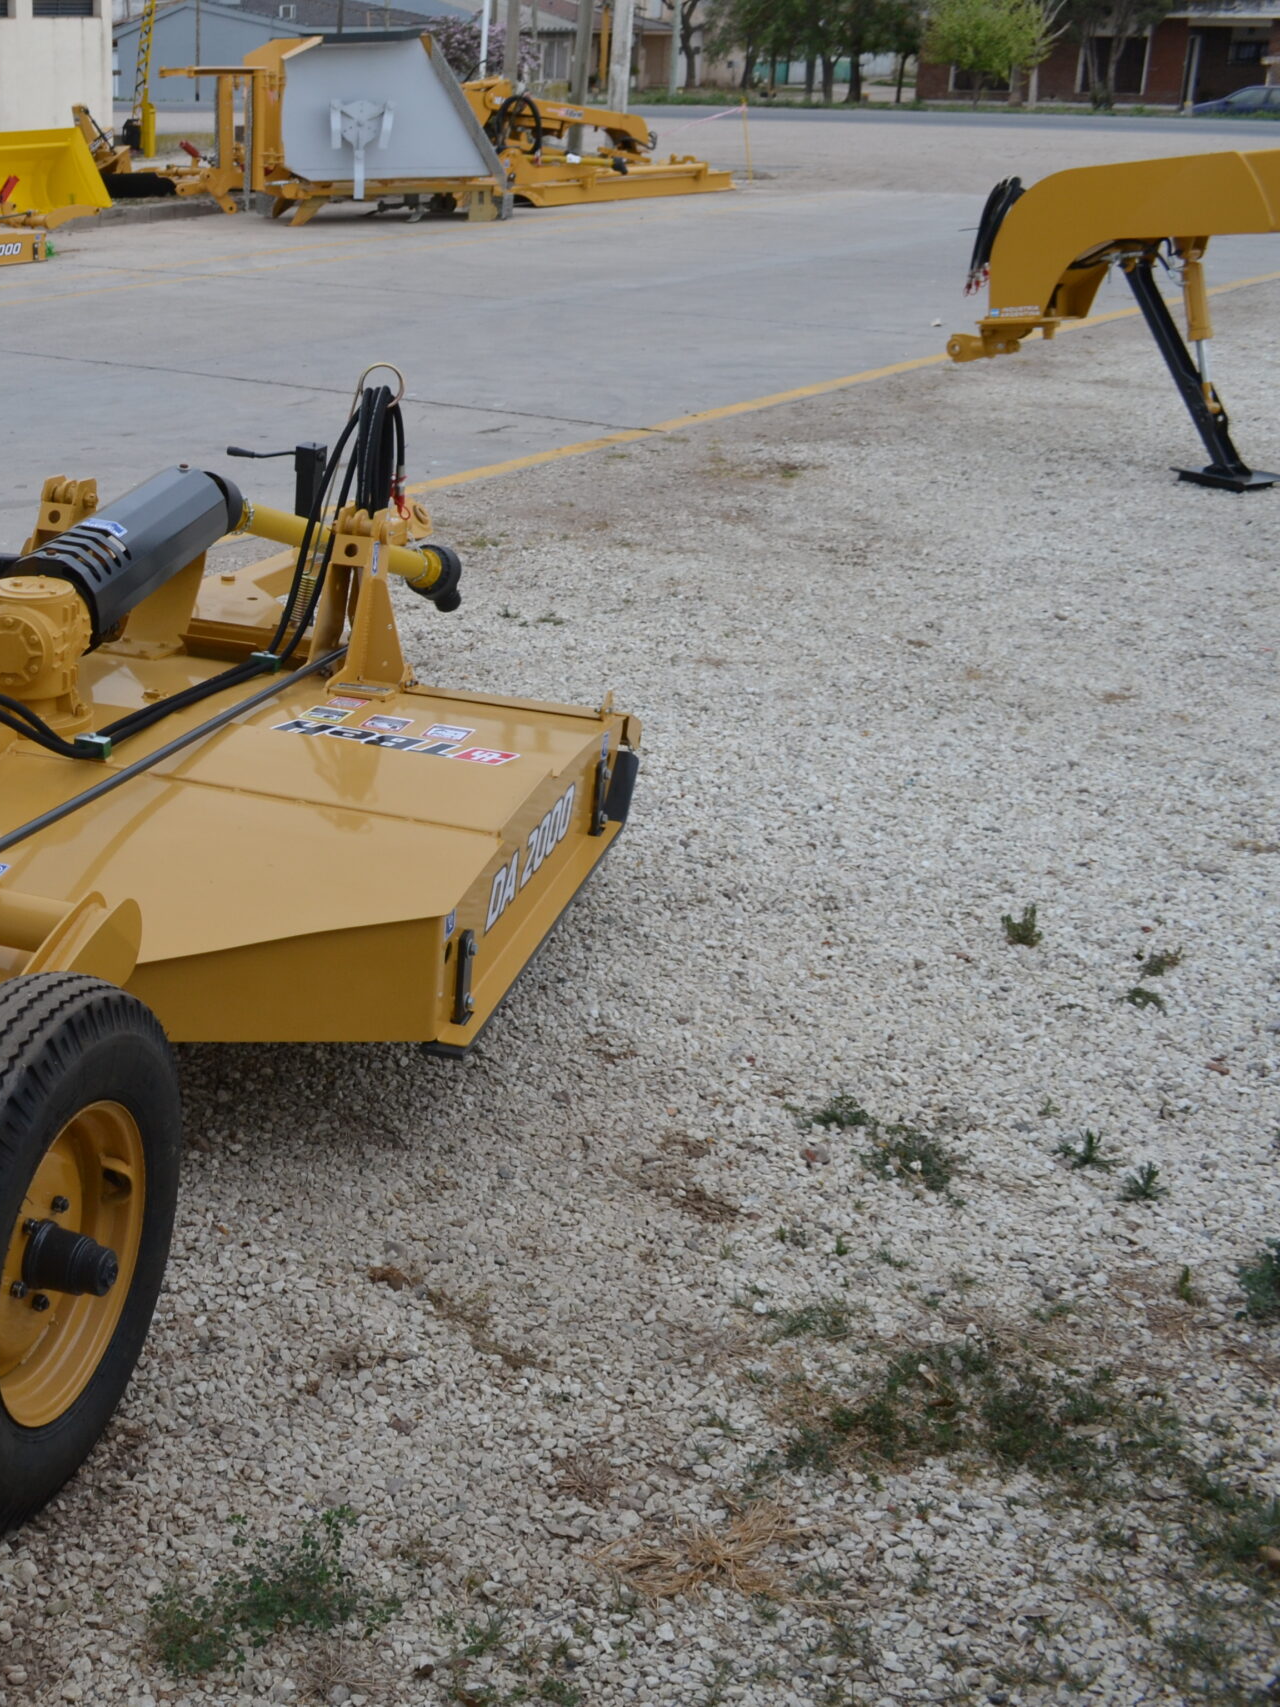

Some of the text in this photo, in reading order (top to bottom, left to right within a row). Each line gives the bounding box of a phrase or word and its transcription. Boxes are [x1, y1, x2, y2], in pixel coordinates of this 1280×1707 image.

[270, 719, 461, 758] TBeH
[484, 782, 576, 937] DA 2000
